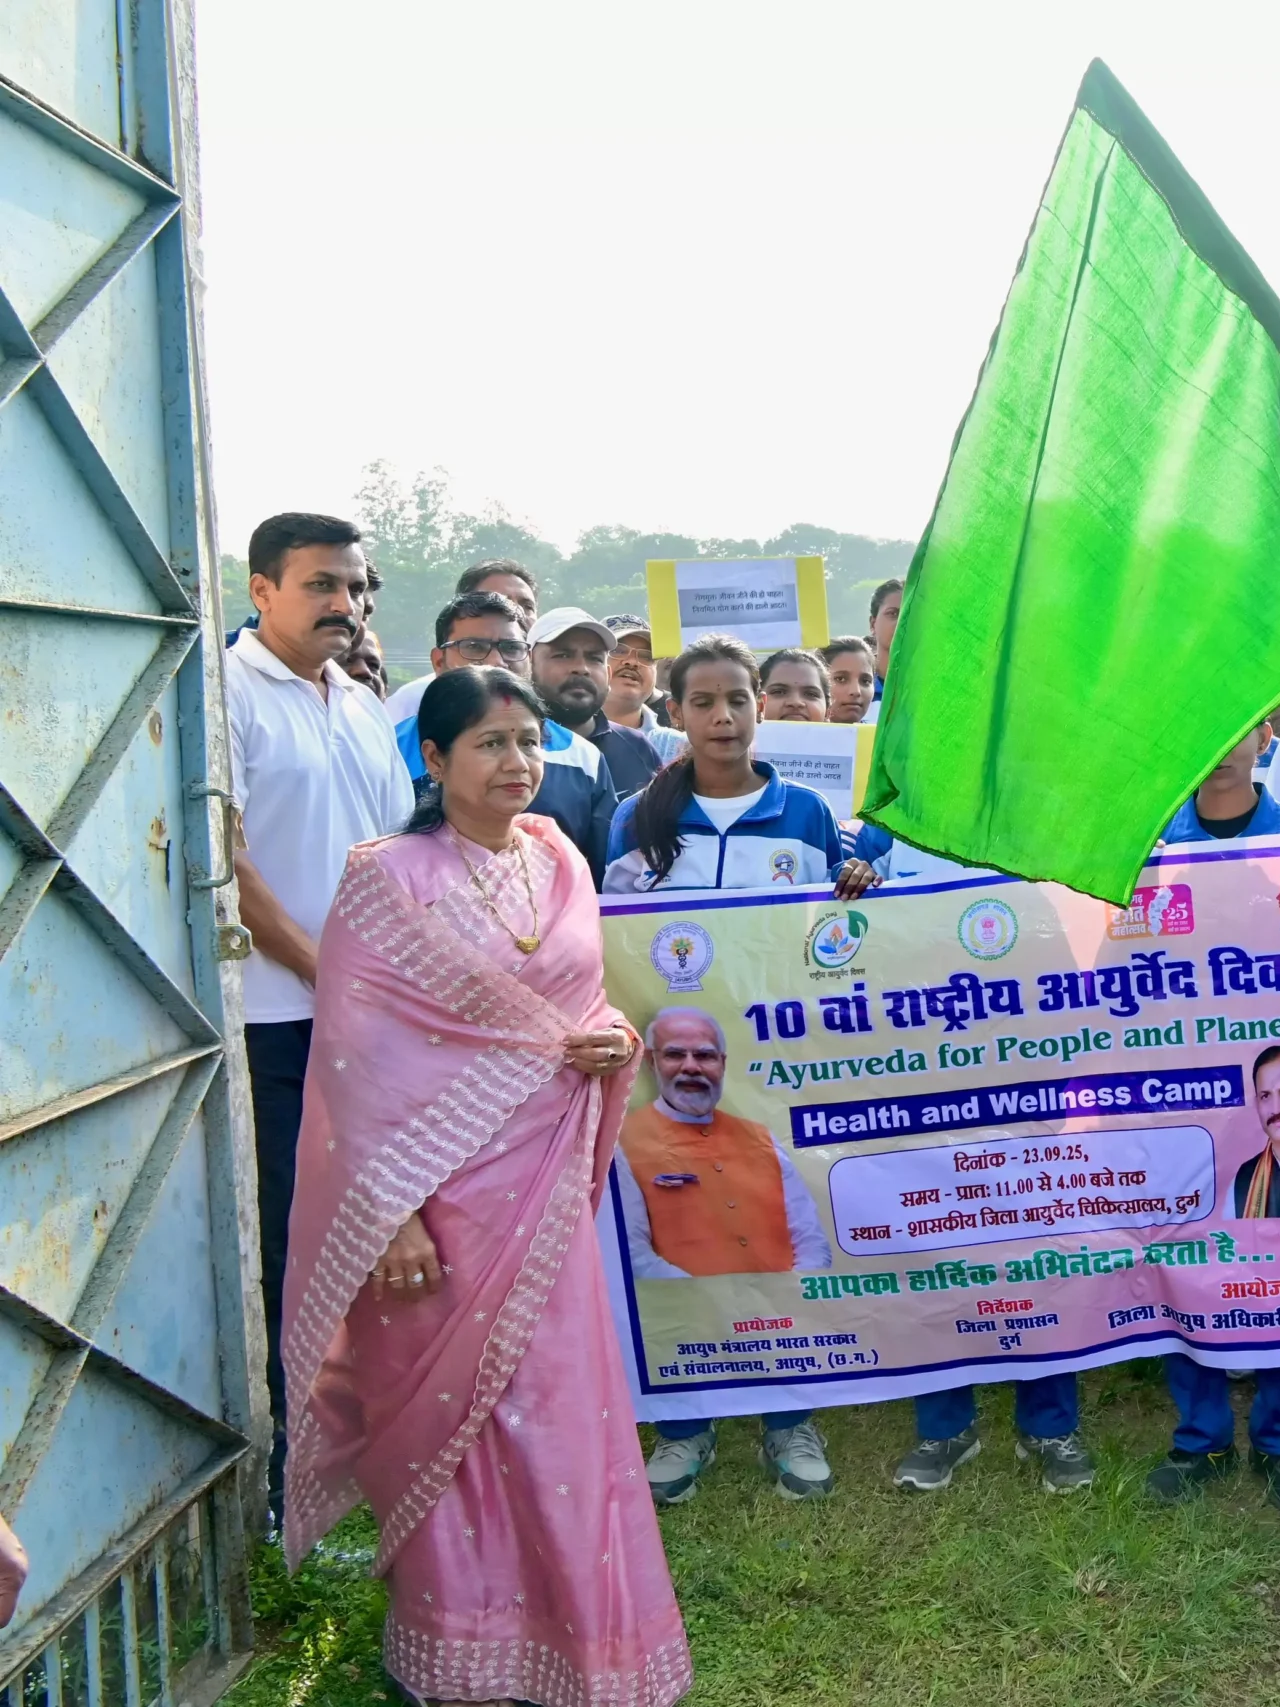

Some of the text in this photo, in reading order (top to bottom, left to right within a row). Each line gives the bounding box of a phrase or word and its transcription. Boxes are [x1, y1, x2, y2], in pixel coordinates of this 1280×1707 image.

[795, 770, 804, 779] की
[804, 760, 812, 768] की
[825, 911, 838, 919] Day
[1166, 902, 1189, 920] 25
[745, 1000, 806, 1042] 10
[820, 982, 873, 1034] वां
[882, 973, 1024, 1032] राष्ट्रीय
[1037, 951, 1198, 1018] आयुर्वेद
[938, 1043, 986, 1069] for
[996, 1028, 1112, 1062] People
[1123, 1020, 1185, 1049] and
[802, 1078, 1232, 1138] Health and Wellness Camp
[953, 1149, 1006, 1173] दिनांक
[1023, 1144, 1090, 1164] 23.09.25,
[899, 1188, 941, 1208] समय
[995, 1178, 1034, 1197] 11.00
[1036, 1171, 1052, 1191] से
[1057, 1173, 1086, 1191] 4.00
[1090, 1167, 1116, 1188] बजे
[1117, 1170, 1147, 1187] तक
[849, 1224, 892, 1241] स्थान
[907, 1209, 977, 1238] शासकीय
[980, 1206, 1019, 1228] जिला
[1022, 1199, 1076, 1226] आयुर्वेद
[1175, 1190, 1201, 1215] दुर्ग
[800, 1271, 900, 1300] आपका
[905, 1259, 998, 1292] हार्दिक
[1005, 1246, 1134, 1283] अभिनंदन
[976, 1297, 1034, 1316] निर्देशक
[1108, 1305, 1156, 1329] जिला
[1160, 1304, 1207, 1333] आयुष
[732, 1316, 793, 1334] प्रायोजक
[955, 1313, 1060, 1334] जिला प्रशासन
[677, 1333, 857, 1358] आयुष मंत्रालय भारत सरकार
[998, 1332, 1022, 1351] दुर्ग
[659, 1349, 880, 1378] एवं संचालनालय, आयुष, (छ.ग.)
